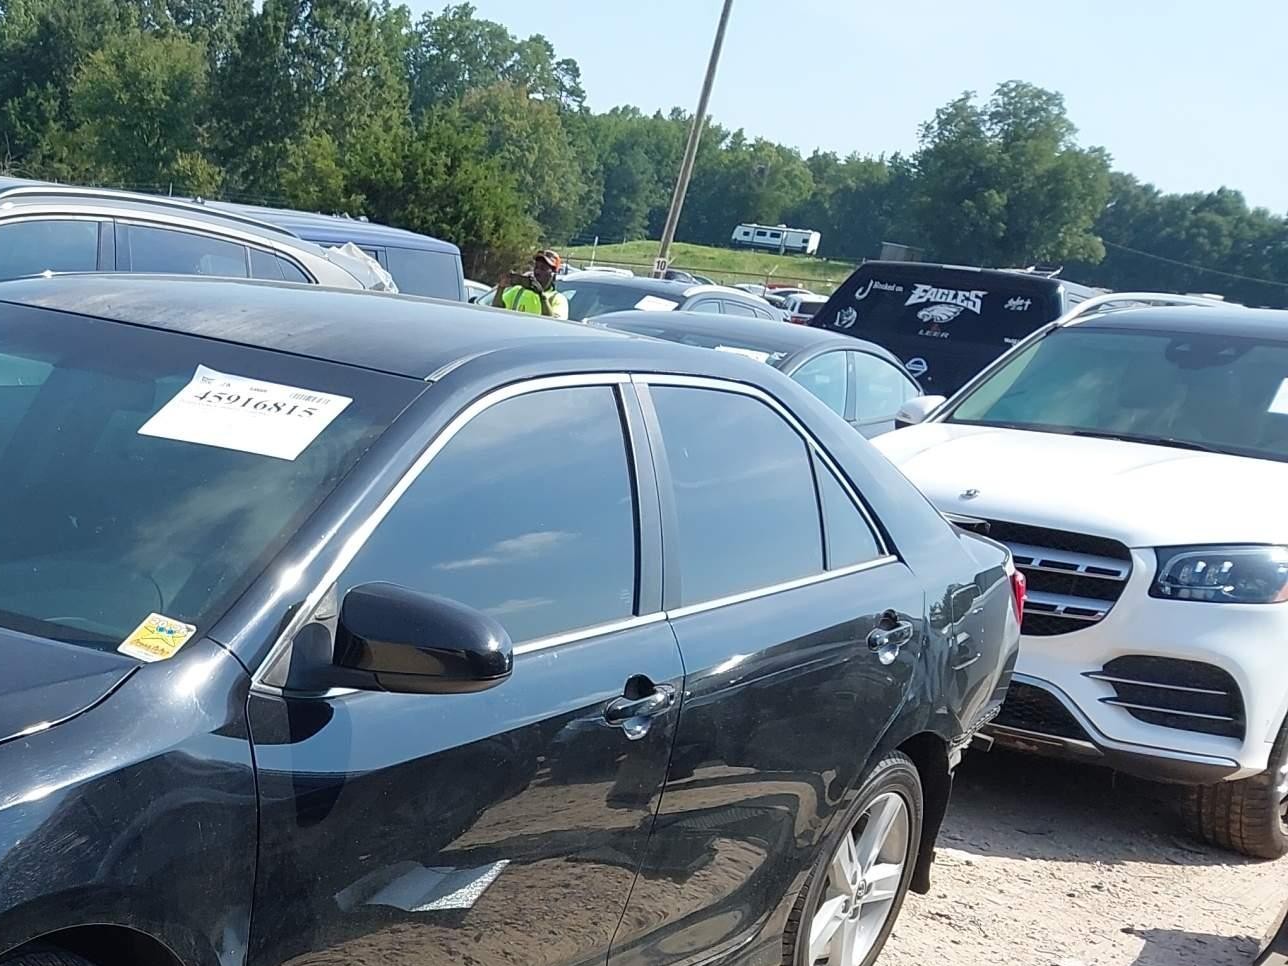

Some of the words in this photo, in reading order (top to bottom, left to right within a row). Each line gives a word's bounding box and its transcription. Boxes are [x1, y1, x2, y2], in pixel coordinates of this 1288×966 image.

[656, 260, 667, 271] 10
[904, 283, 989, 315] EAGLES
[918, 329, 950, 339] LEER
[193, 389, 319, 418] 45916815
